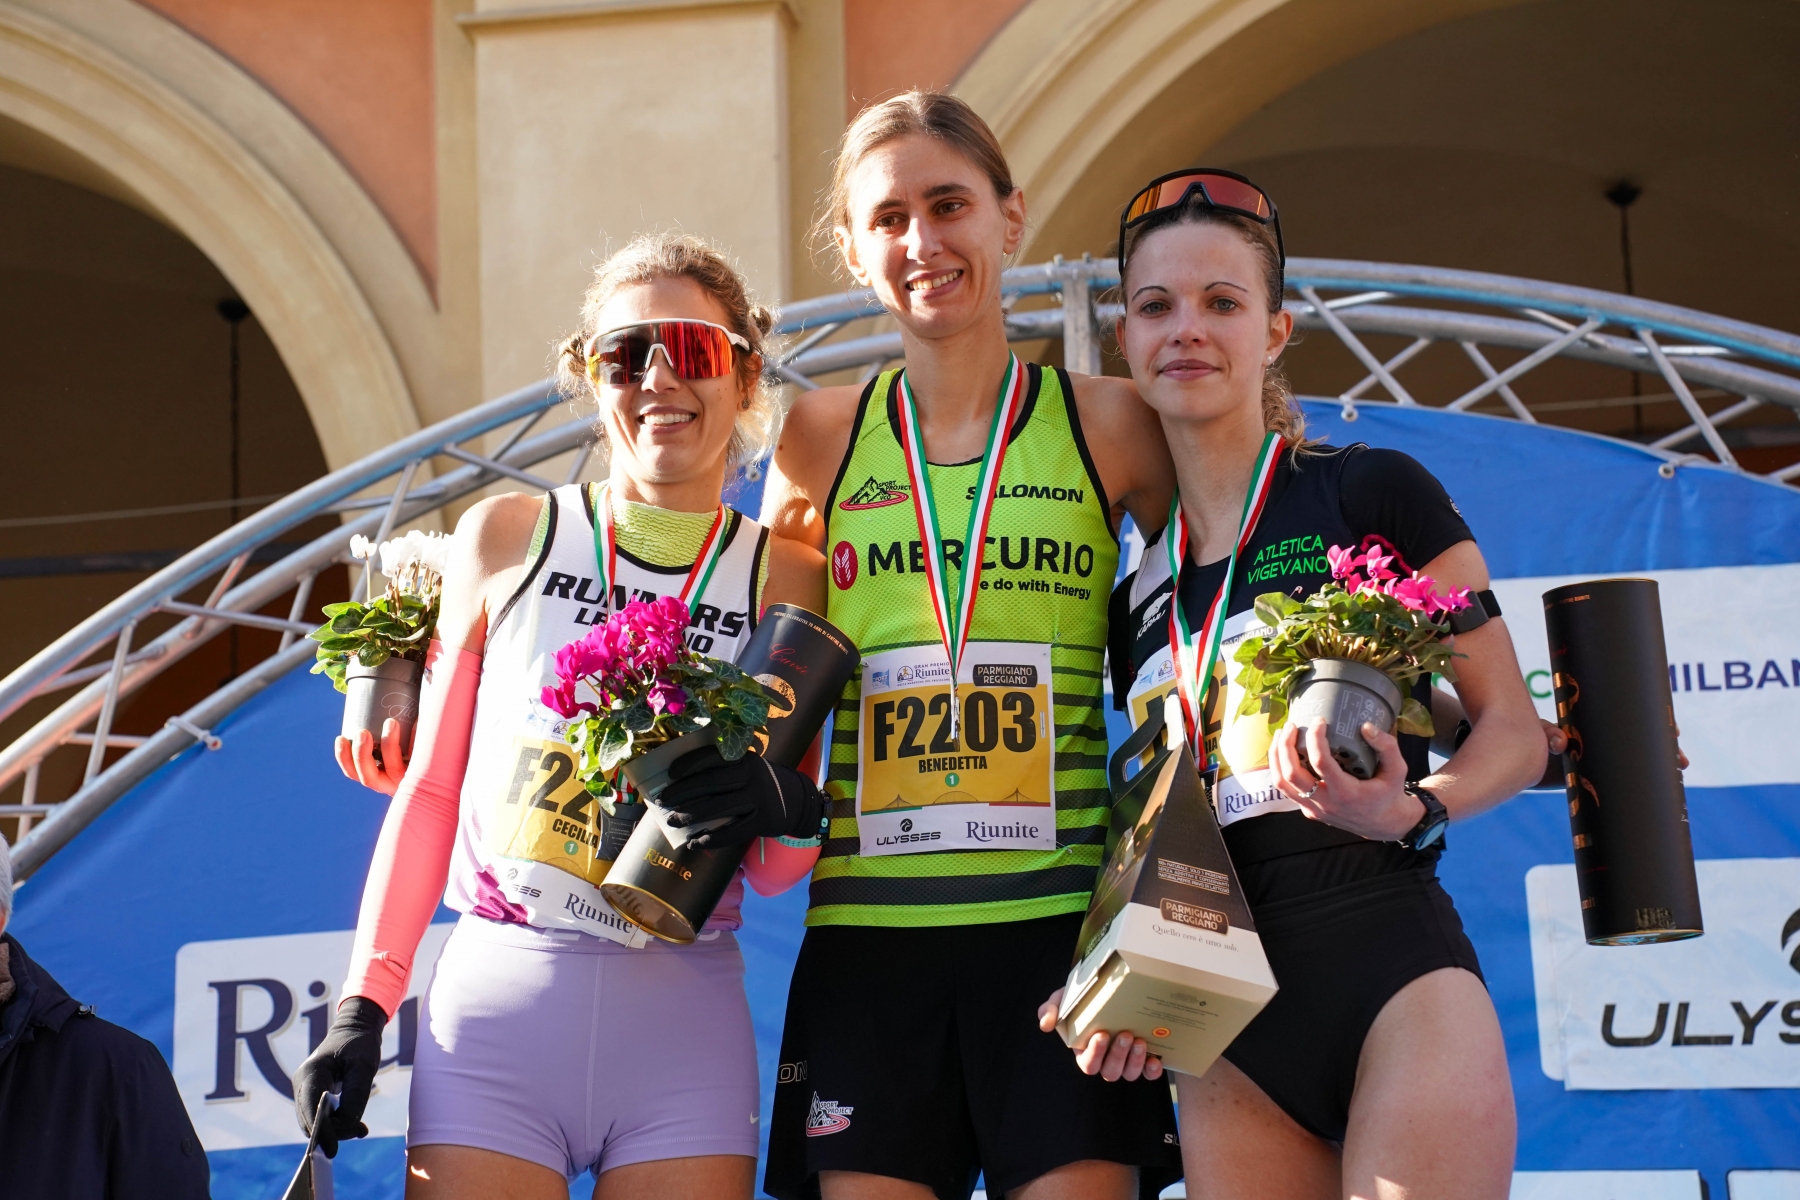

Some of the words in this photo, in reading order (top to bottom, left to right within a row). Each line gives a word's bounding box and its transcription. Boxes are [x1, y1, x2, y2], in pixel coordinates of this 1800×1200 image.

[965, 484, 1084, 504] SLOMON
[1253, 534, 1324, 566] ATLETICA
[1247, 555, 1329, 585] VIGEVANO
[993, 578, 1014, 590] do
[1018, 579, 1050, 592] with
[1054, 582, 1091, 600] Energy
[541, 571, 748, 638] RUNRS
[915, 667, 950, 679] Riunite
[977, 666, 1033, 676] PARMIGIANO
[983, 675, 1028, 685] REGGIANO
[873, 690, 1037, 762] F2203
[918, 755, 988, 773] BENEDETTA
[1224, 785, 1289, 815] Riunit
[552, 818, 599, 849] CECILIA
[876, 831, 942, 846] ULYSSES
[965, 821, 1039, 842] Riunite
[563, 892, 633, 933] Riunite
[1165, 901, 1223, 923] PARMIGIANO
[1171, 911, 1218, 931] REGGIANO
[1152, 924, 1181, 937] Quello
[1182, 933, 1197, 942] vero
[1205, 939, 1222, 948] uno
